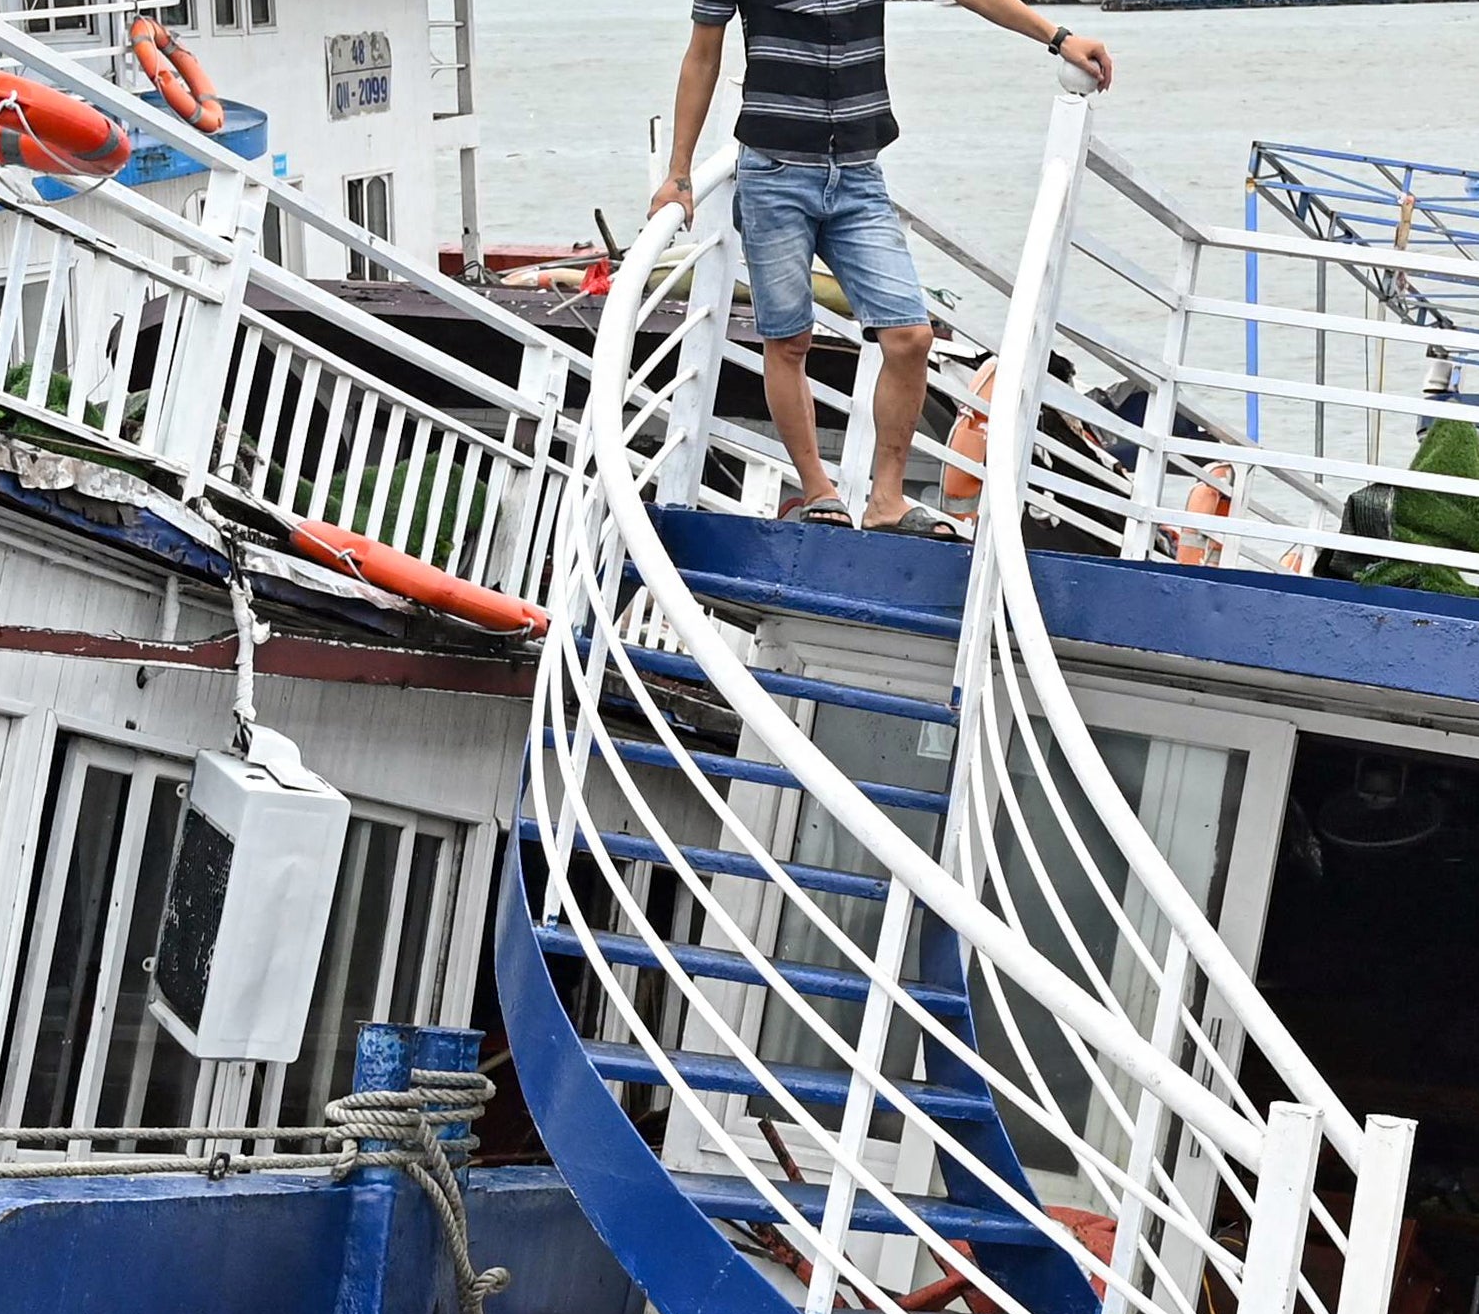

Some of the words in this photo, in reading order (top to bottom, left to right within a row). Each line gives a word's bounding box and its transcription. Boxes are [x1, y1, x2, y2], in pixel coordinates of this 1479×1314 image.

[350, 38, 365, 65] 48
[336, 81, 351, 113] QN
[359, 75, 388, 106] 2099
